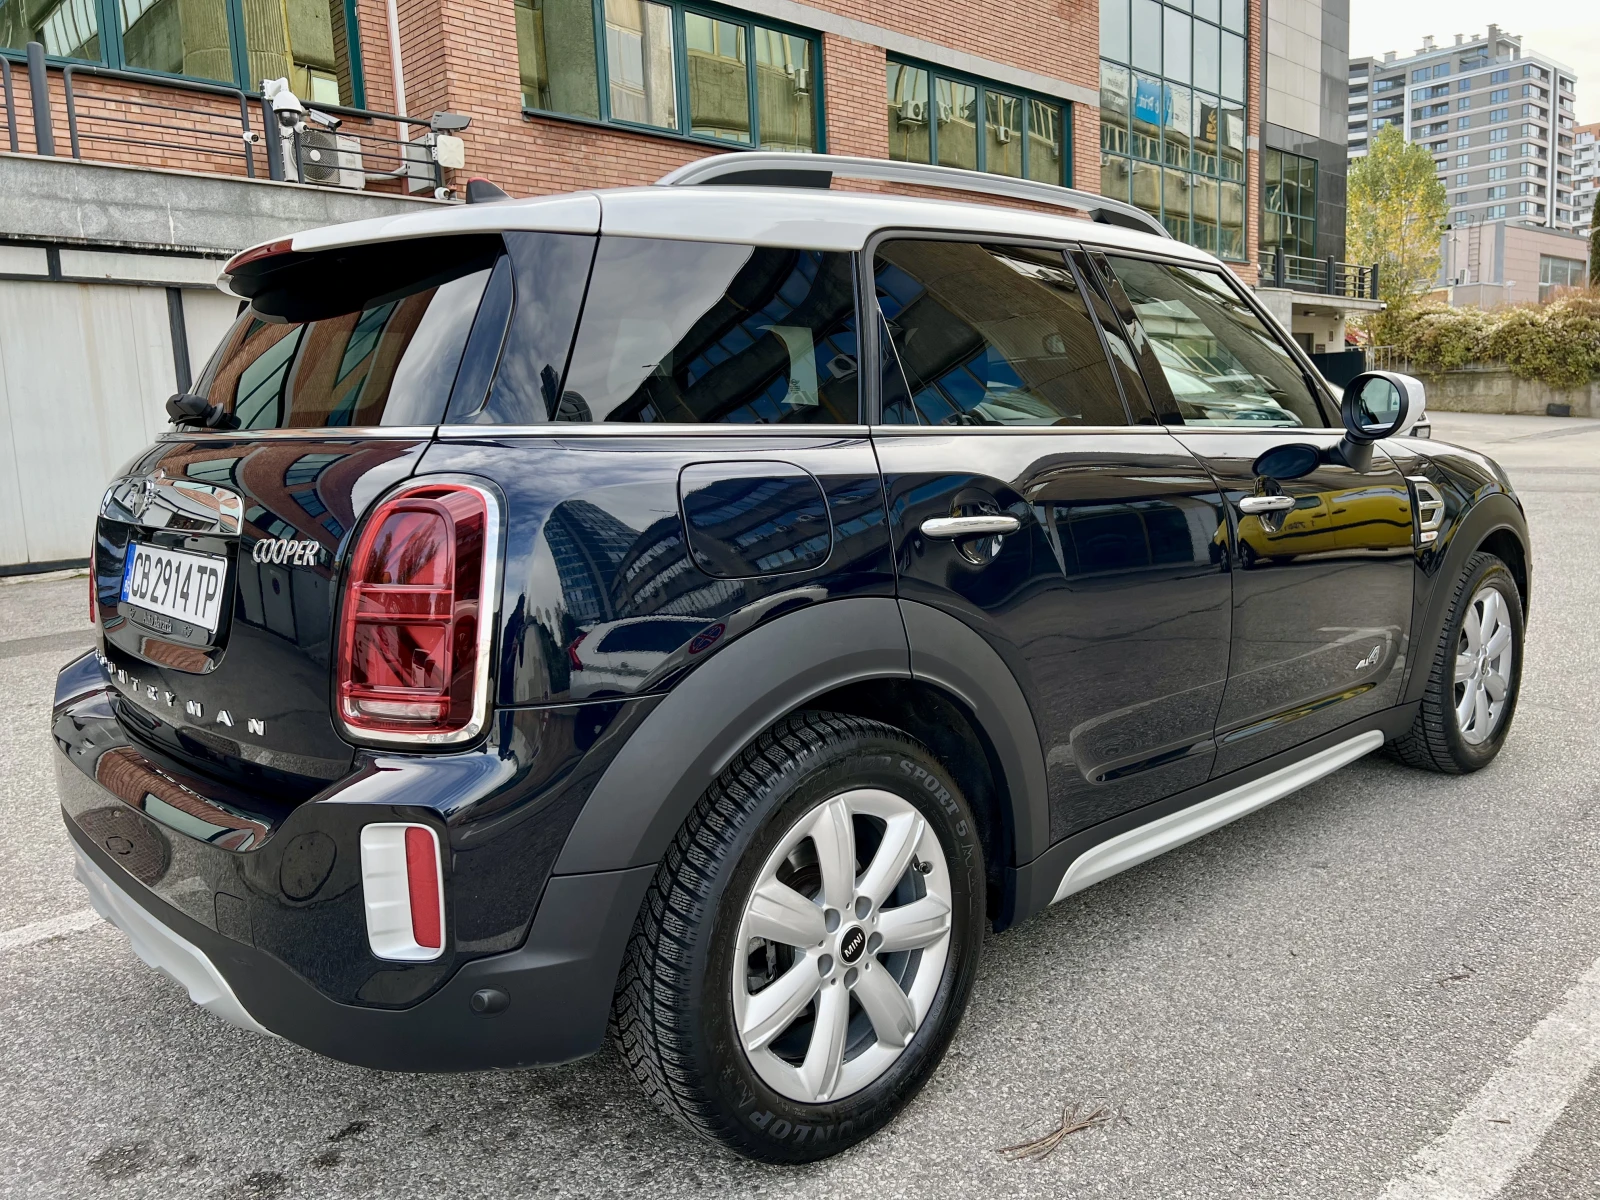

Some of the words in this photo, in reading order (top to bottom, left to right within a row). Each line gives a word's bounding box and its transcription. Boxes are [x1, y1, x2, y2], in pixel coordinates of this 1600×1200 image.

[252, 537, 320, 566] COOPER
[95, 648, 266, 736] COUNTRYMAN
[899, 759, 961, 816] SPORT
[955, 819, 970, 837] 5
[844, 932, 864, 957] MINI
